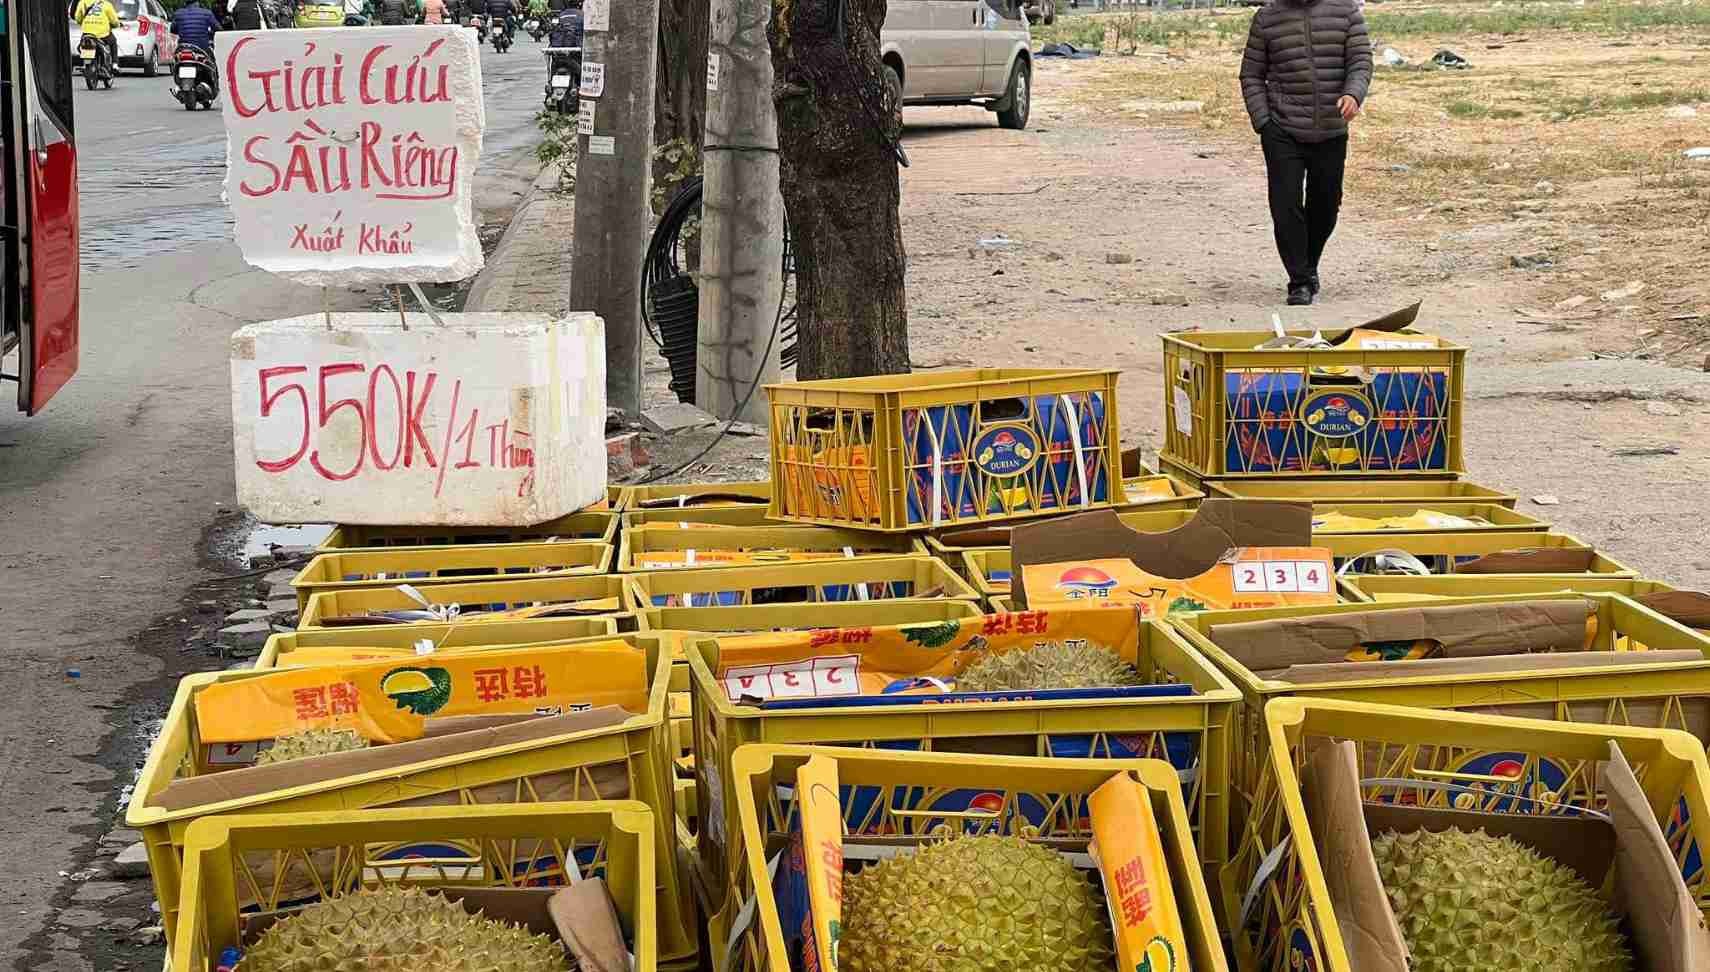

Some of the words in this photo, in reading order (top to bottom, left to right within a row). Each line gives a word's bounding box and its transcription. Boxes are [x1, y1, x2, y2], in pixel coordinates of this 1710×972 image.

[226, 37, 348, 117] Giải
[360, 38, 451, 104] Cứu
[360, 121, 458, 200] Riêng
[290, 210, 344, 252] Xuất
[1320, 423, 1352, 431] DURIAN
[1244, 569, 1257, 585] 2
[1274, 569, 1287, 585] 3
[1306, 568, 1319, 584] 4
